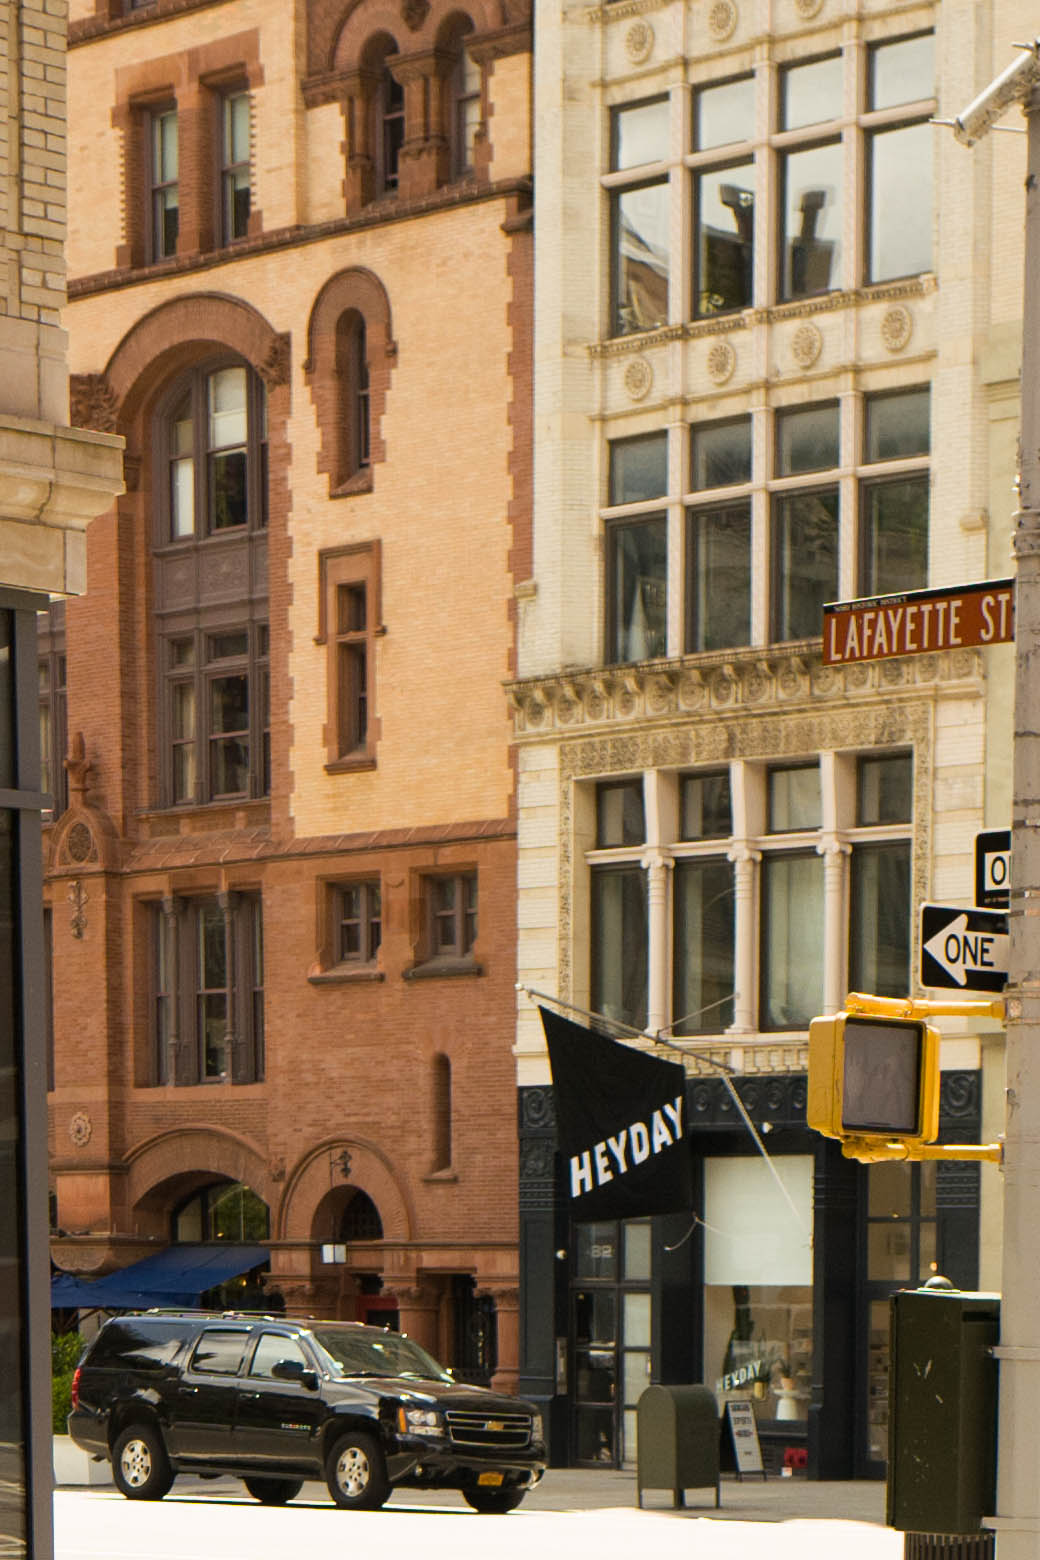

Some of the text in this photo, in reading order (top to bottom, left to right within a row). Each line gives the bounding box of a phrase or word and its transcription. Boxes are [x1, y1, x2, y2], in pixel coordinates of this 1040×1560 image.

[830, 593, 1011, 661] LAFAYETTE ST
[944, 933, 995, 967] ONE
[569, 1095, 683, 1198] HEYDAY
